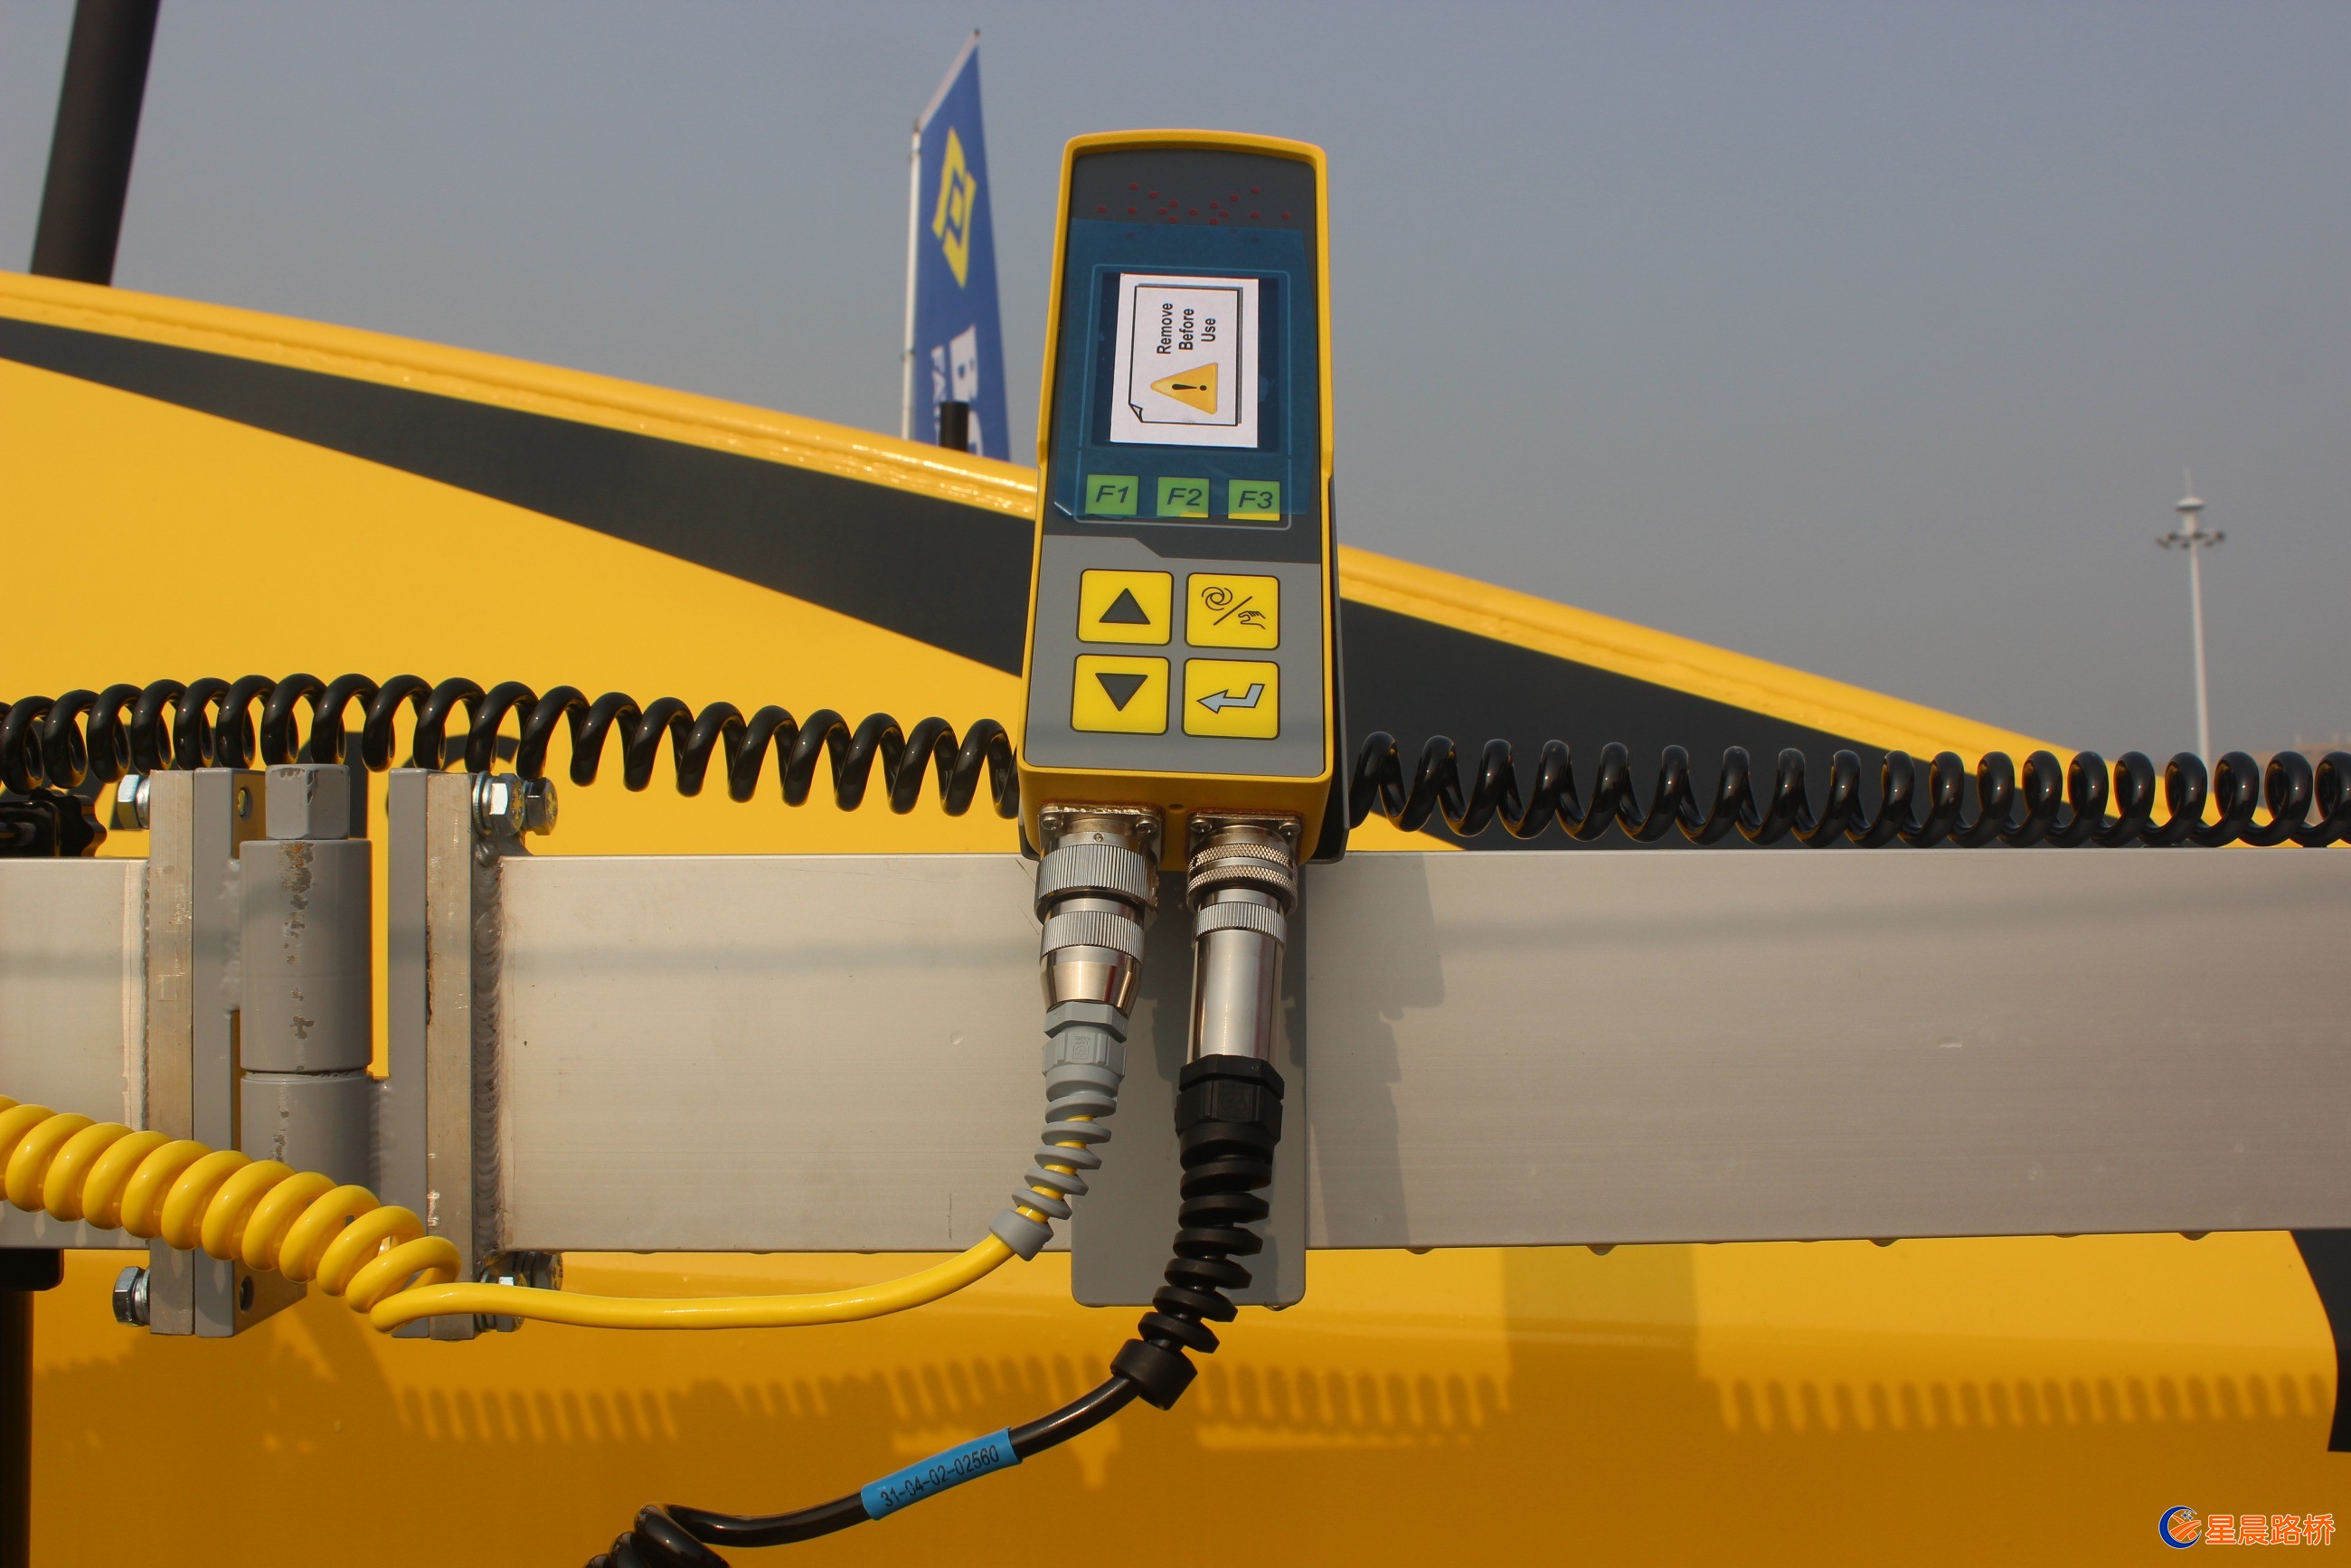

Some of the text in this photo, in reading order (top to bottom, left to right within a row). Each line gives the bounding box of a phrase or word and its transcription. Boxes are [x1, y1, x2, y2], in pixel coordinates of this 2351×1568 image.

[1157, 302, 1174, 354] Remove
[1178, 307, 1194, 351] Before
[1200, 317, 1216, 343] Use
[1095, 485, 1129, 504] F1
[1166, 487, 1203, 506] F2
[1238, 490, 1273, 509] F3
[880, 1444, 1000, 1508] 31-04-02-02560
